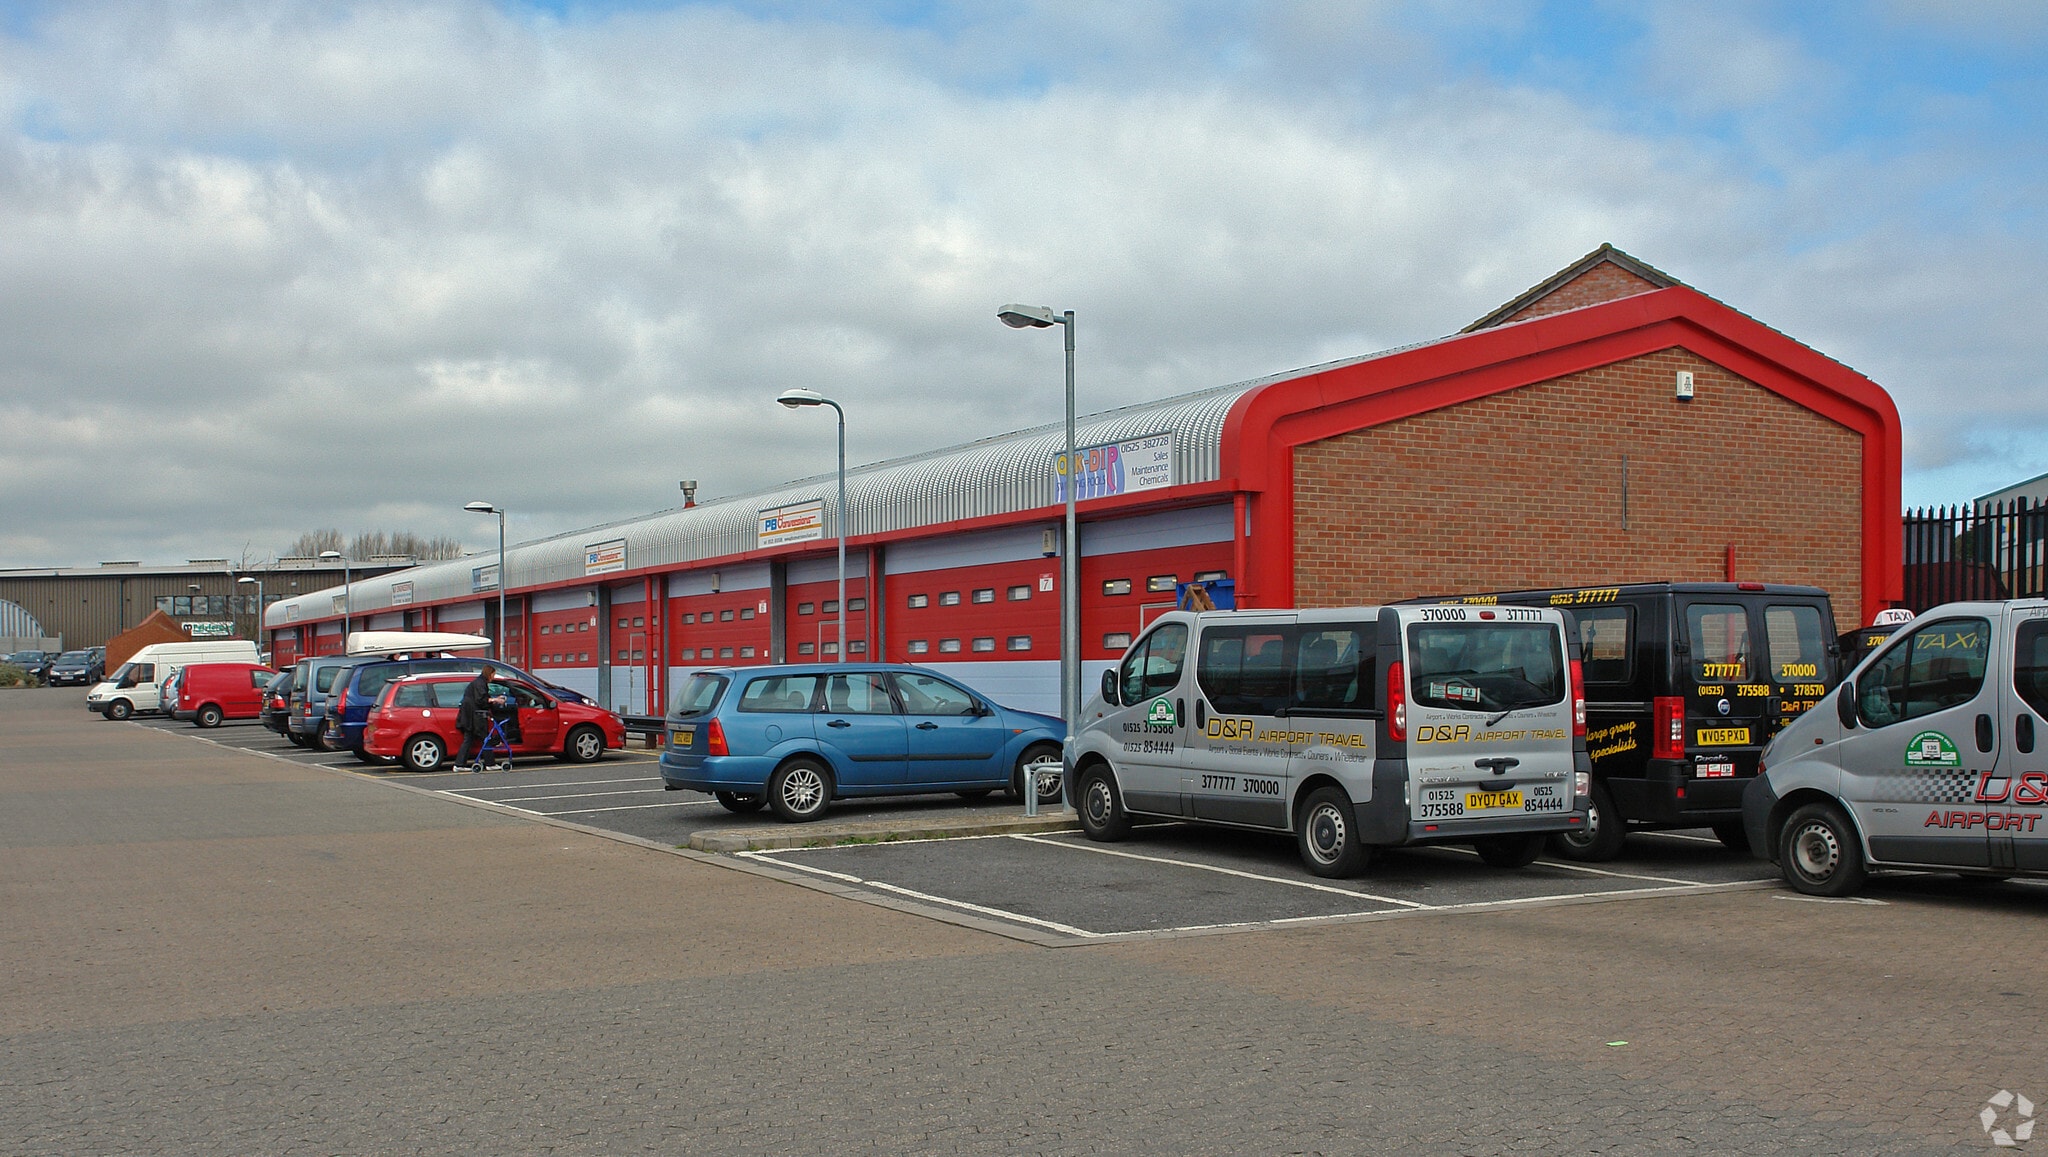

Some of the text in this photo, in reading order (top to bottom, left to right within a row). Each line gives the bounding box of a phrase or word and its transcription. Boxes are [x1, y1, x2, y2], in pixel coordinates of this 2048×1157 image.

[1121, 436, 1169, 454] 01525 382728
[1153, 450, 1169, 462] Sales
[1131, 462, 1169, 477] Maintenance
[1139, 474, 1169, 487] Chemicals
[765, 518, 777, 532] PB
[1043, 579, 1049, 590] 7
[1550, 588, 1620, 605] 01525 377777
[1421, 608, 1542, 622] 370000 377777
[1886, 611, 1914, 622] TAXI
[1703, 663, 1817, 677] 377777 370000
[1698, 684, 1825, 697] (01525) 375588 378570
[1122, 722, 1141, 733] 01525
[1206, 717, 1367, 749] D&R AIRPORT TRAVEL
[1416, 724, 1568, 743] D&R AIRPORT TRAVEL
[1608, 720, 1637, 740] group
[1701, 730, 1746, 743] WV05 PXD
[1123, 740, 1175, 755] 01525 854444
[1208, 743, 1225, 755] Airport
[1590, 736, 1638, 763] specialists
[1201, 774, 1280, 796] 377777 370000
[1533, 786, 1553, 797] 01525
[1428, 791, 1455, 801] 01525
[1470, 793, 1519, 807] DY07 GAX
[1421, 803, 1464, 818] 375588
[1525, 797, 1563, 812] 854444
[1924, 810, 2042, 832] AIRPORT
